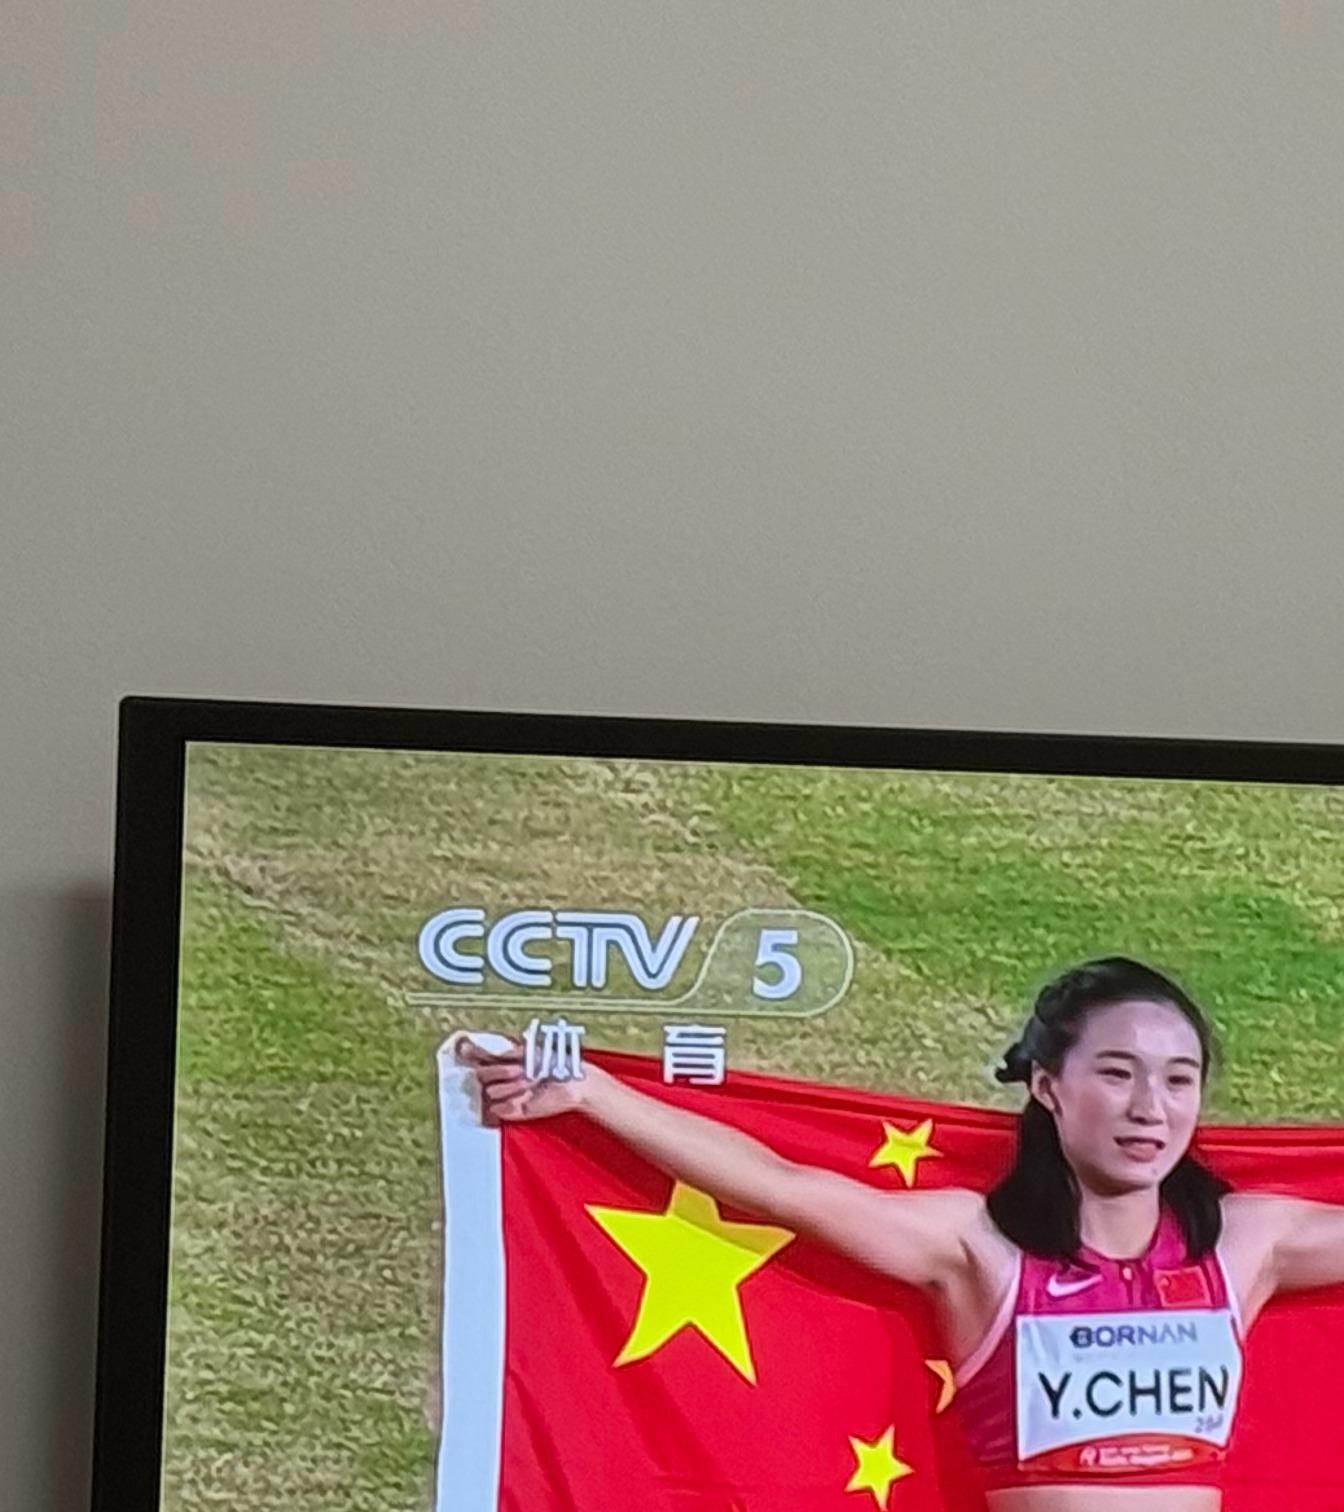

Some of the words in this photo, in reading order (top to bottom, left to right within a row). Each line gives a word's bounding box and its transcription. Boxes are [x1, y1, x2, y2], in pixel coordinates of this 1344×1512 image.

[418, 908, 700, 990] CCTV
[752, 929, 803, 1000] 5
[522, 1017, 728, 1086] 体育
[1069, 1322, 1199, 1349] BORNAN
[1038, 1365, 1230, 1419] Y.CHEN
